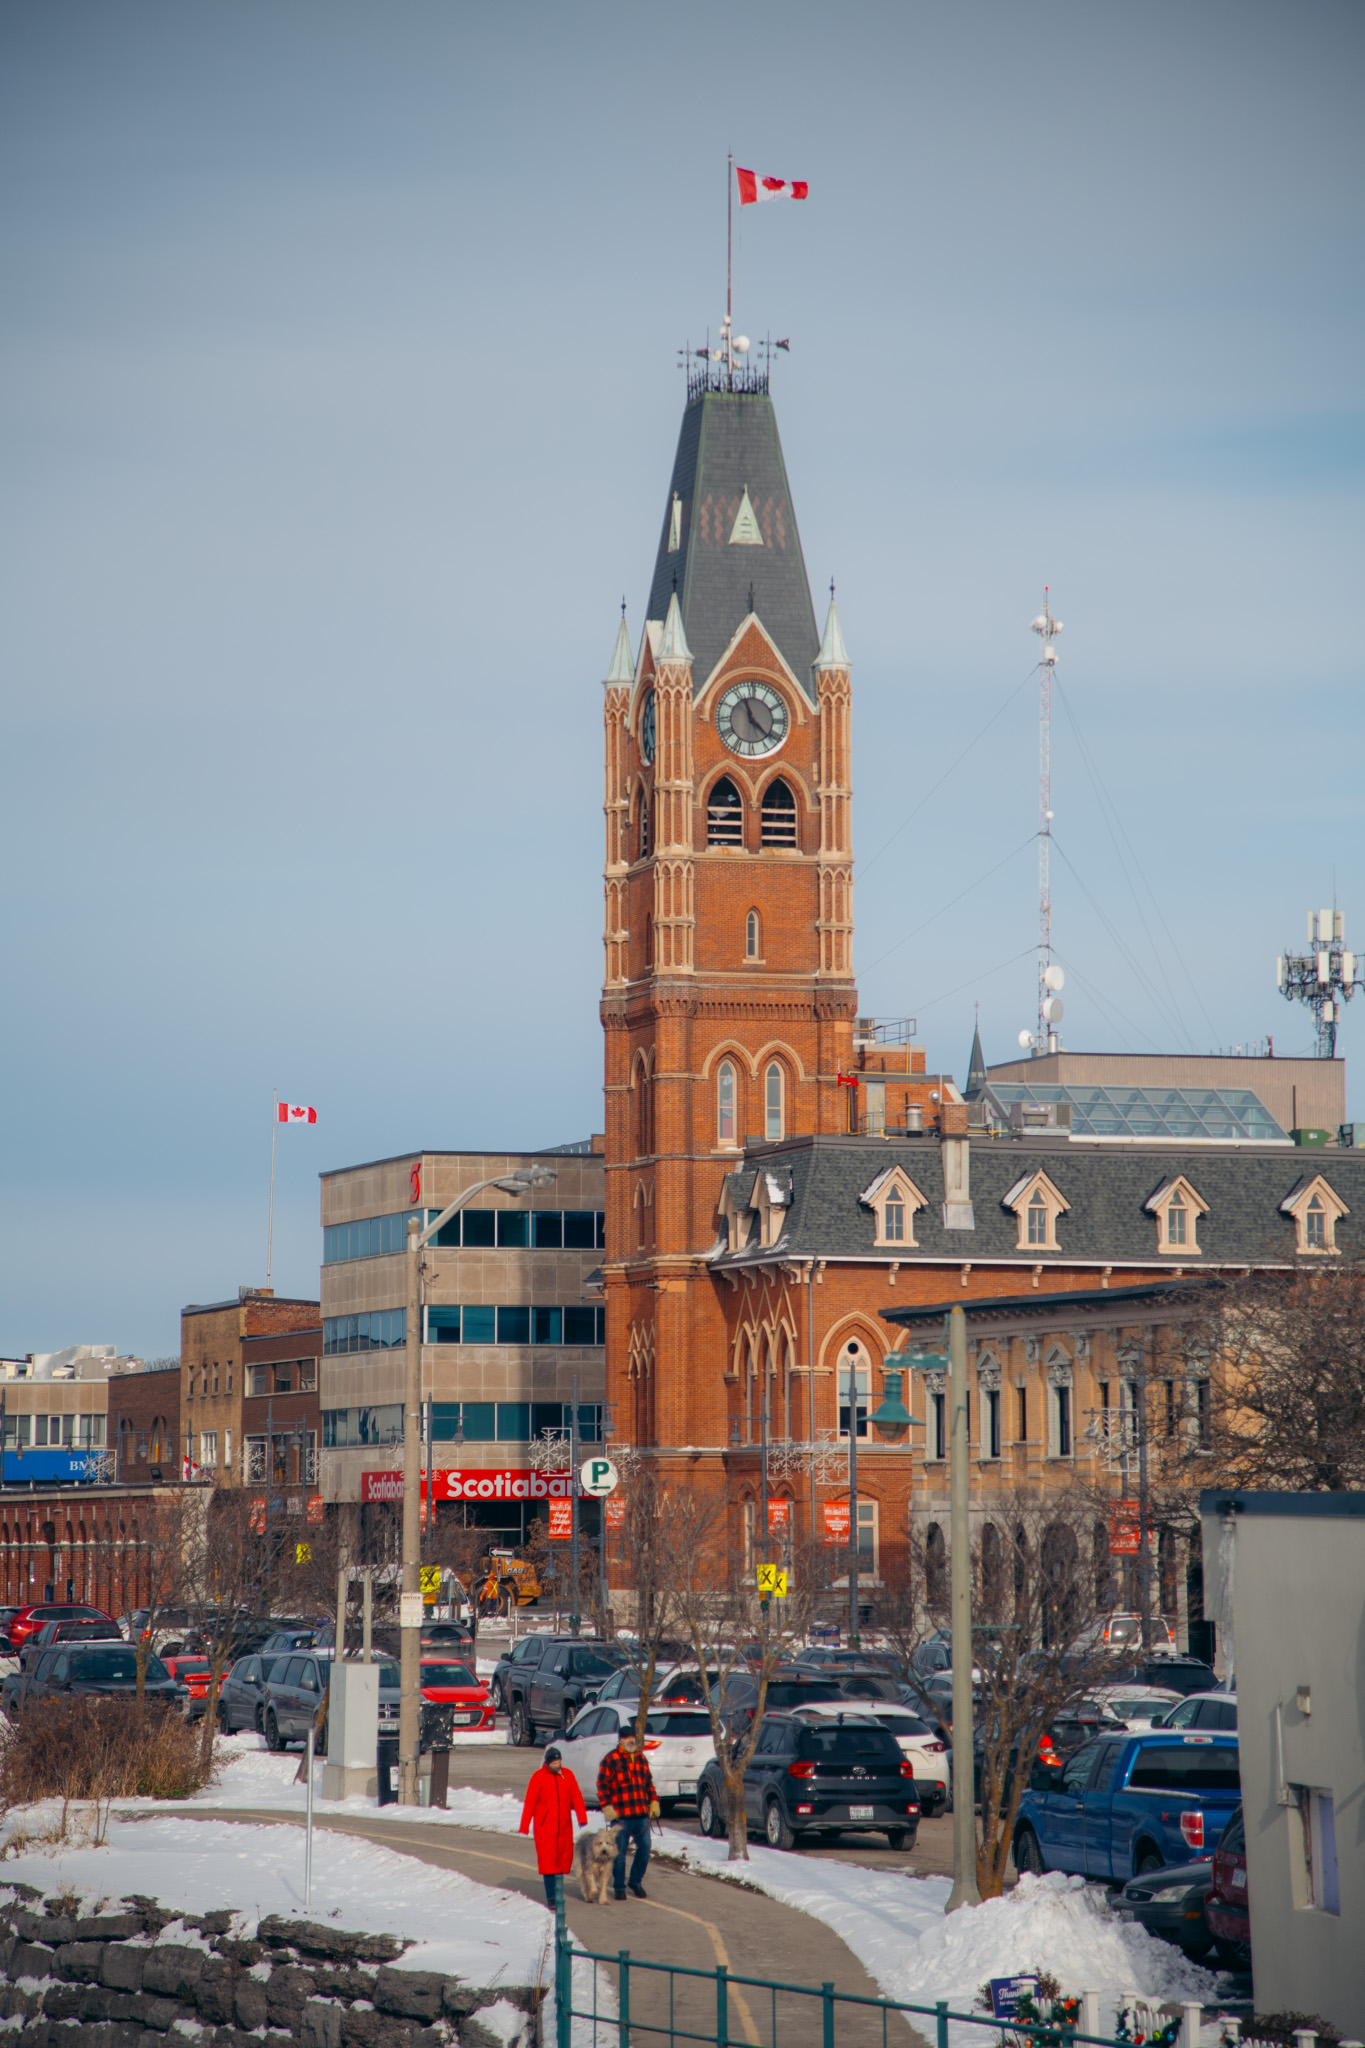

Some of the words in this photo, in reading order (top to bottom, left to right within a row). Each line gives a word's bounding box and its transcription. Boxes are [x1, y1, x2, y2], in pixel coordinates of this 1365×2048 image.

[446, 1472, 590, 1498] Scotiaban
[592, 1462, 610, 1484] P
[368, 1474, 404, 1499] Scotiaba
